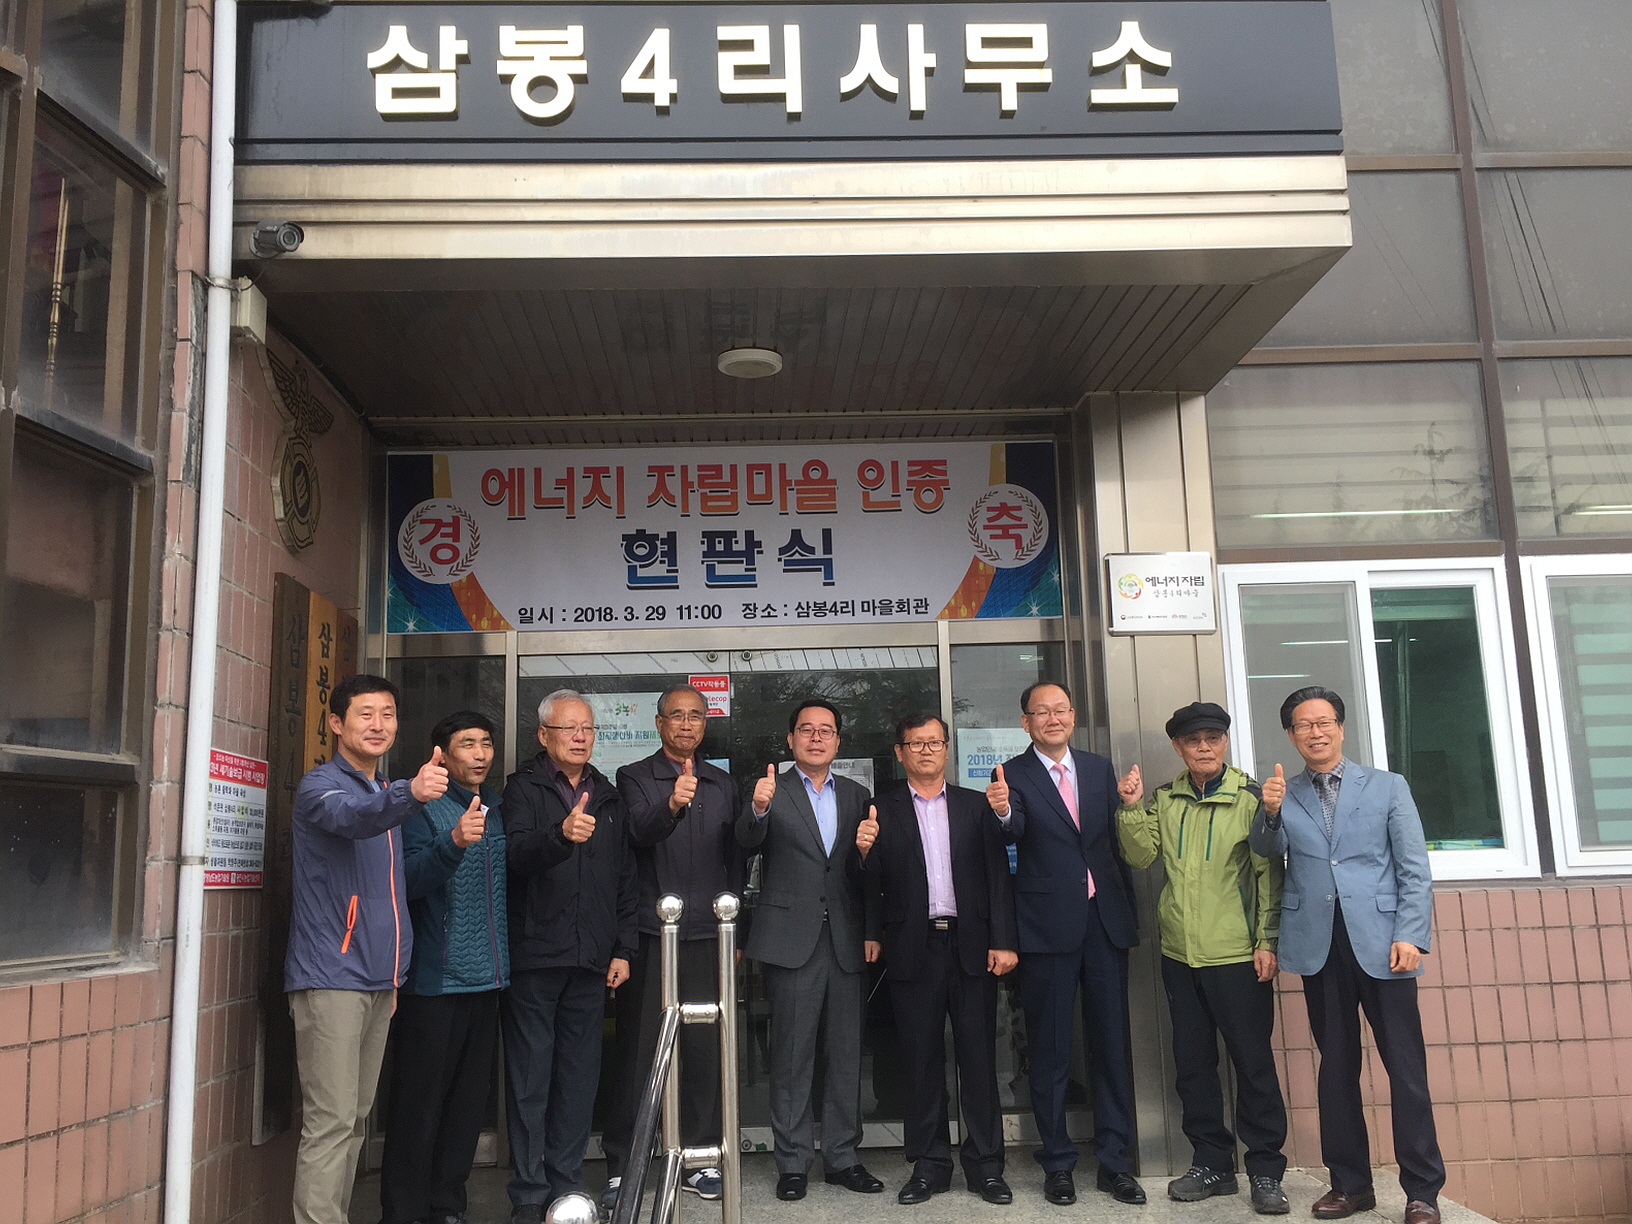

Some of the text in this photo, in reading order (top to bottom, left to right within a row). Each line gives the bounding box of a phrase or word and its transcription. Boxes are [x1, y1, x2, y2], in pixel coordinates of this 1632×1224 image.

[366, 21, 1180, 121] 삼봉4리사무소
[480, 458, 951, 521] 에너지 자립마을 인증
[982, 501, 1029, 550] 축
[418, 515, 461, 566] 경
[1145, 575, 1205, 587] 에너지 자립
[644, 605, 667, 621] 29
[676, 603, 722, 621] 11:00
[794, 598, 856, 618] 삼봉4리
[860, 597, 930, 617] 마을회관
[967, 753, 1003, 766] 2018년
[220, 765, 242, 780] 새기술보급
[243, 770, 252, 782] 시범
[253, 772, 265, 785] 사업장
